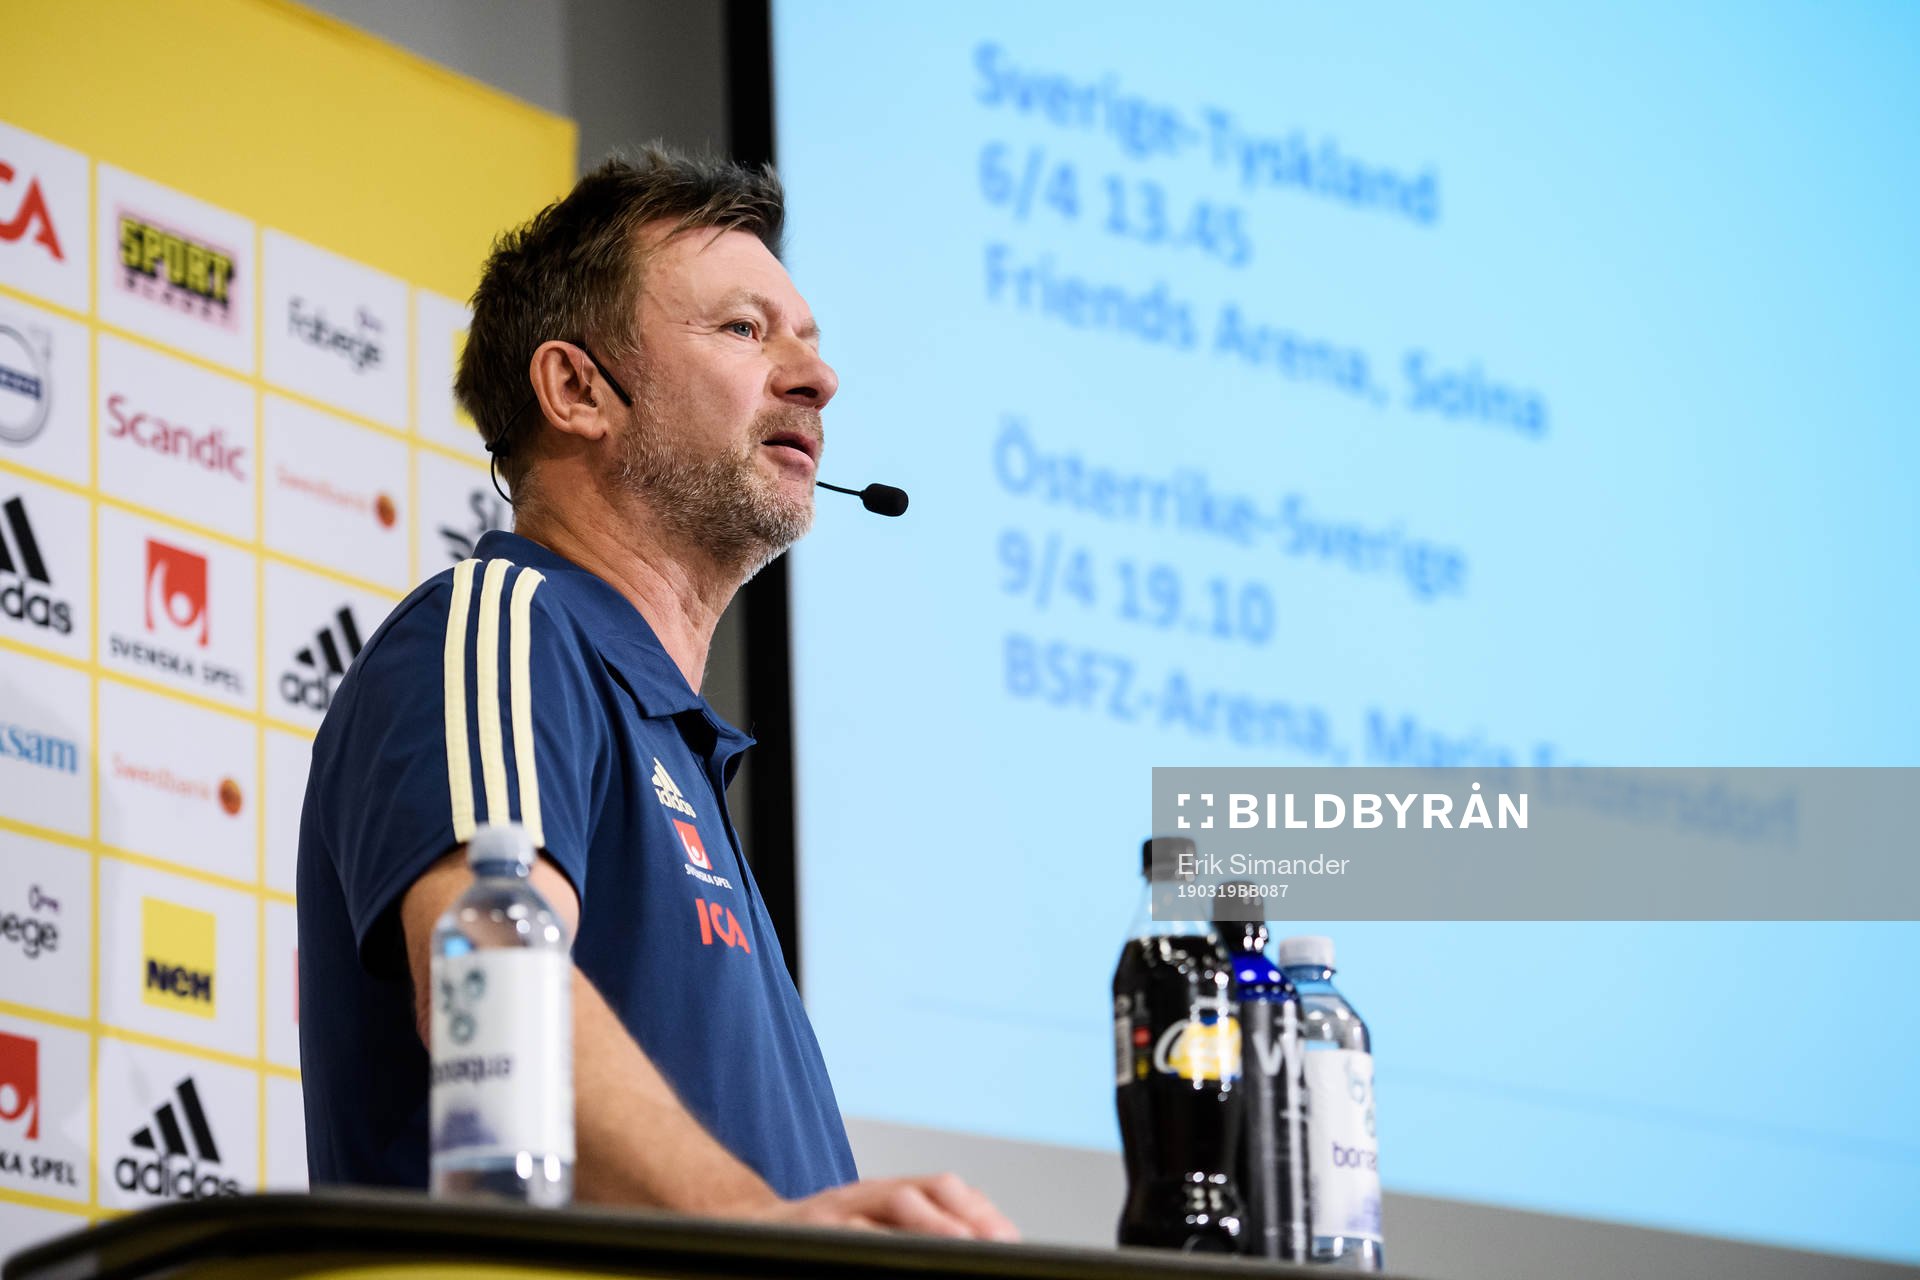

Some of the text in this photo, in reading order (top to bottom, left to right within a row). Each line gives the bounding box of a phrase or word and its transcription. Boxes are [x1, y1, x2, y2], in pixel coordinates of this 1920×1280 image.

[973, 42, 1440, 227] Sverige-Tyskland
[977, 141, 1254, 268] 6/4 13.45
[120, 213, 236, 310] SPORT
[984, 242, 1551, 441] Friends Arena, Solna
[107, 395, 246, 480] Scandic
[993, 416, 1471, 602] Österrike-Sverige
[996, 530, 1276, 648] 9/4 19.10
[110, 636, 244, 694] SVENSKA SPEL
[1004, 635, 1350, 766] BSFZ-Arena,
[695, 898, 751, 955] ICA
[713, 874, 733, 890] SPEL
[30, 1153, 77, 1188] SPEL
[115, 1155, 241, 1199] adidas
